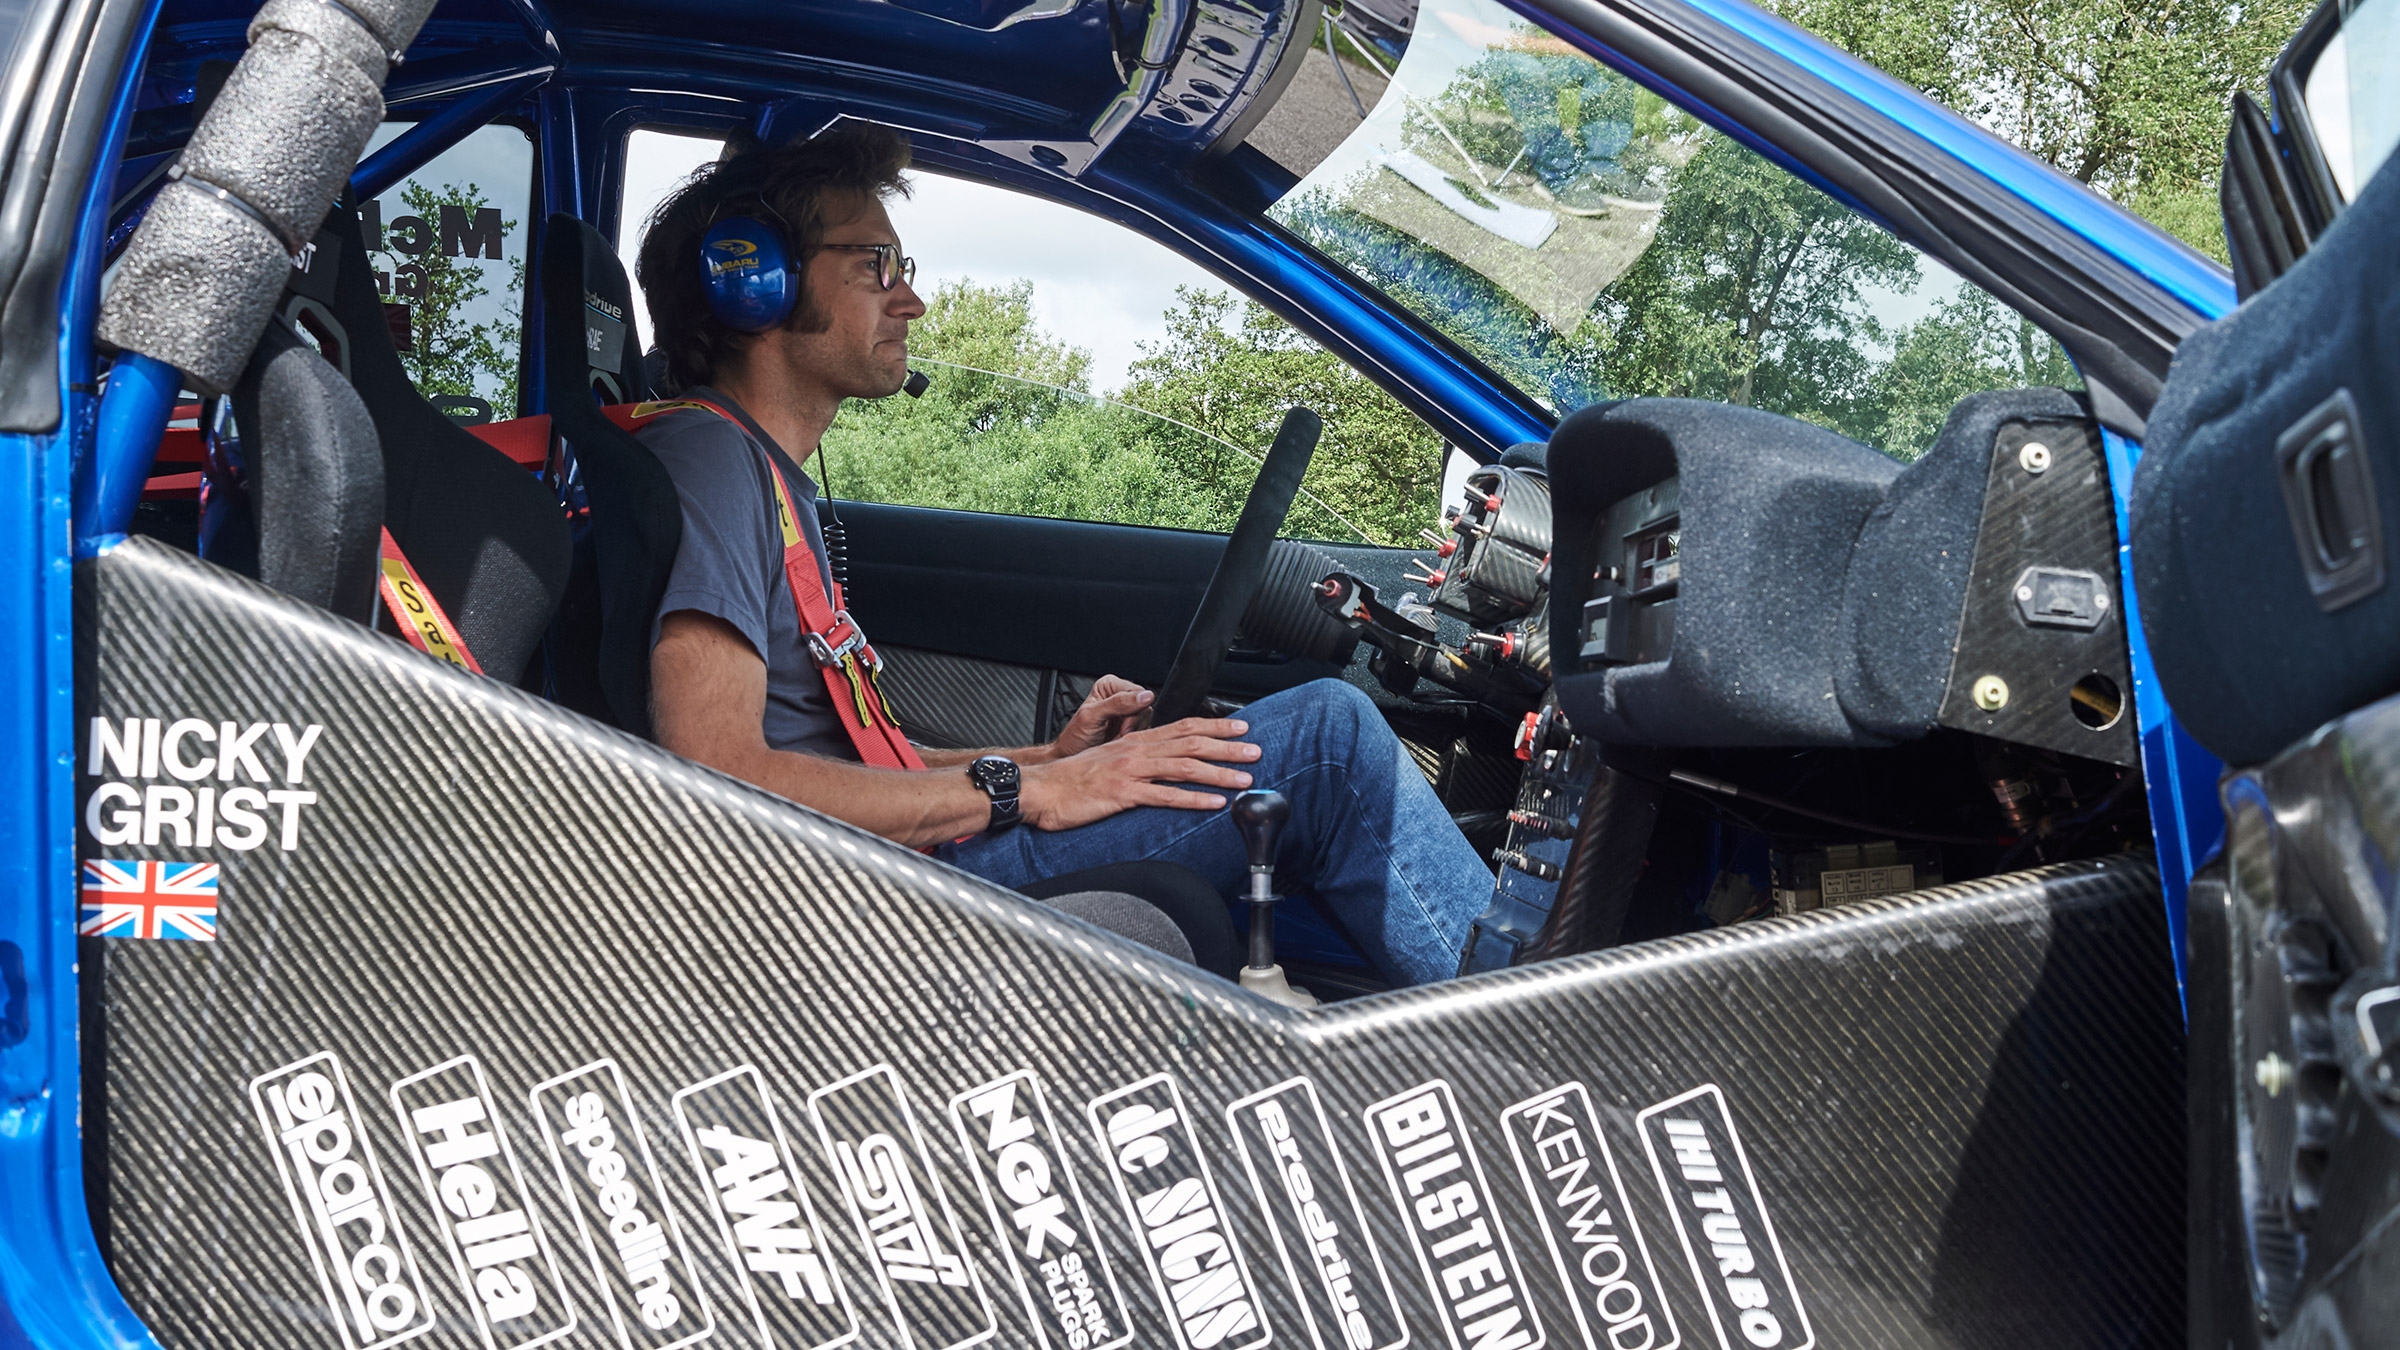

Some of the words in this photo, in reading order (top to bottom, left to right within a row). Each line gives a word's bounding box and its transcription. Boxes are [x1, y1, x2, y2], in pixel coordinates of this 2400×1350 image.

[85, 781, 318, 851] GRIST
[88, 716, 324, 784] NICKY
[267, 1071, 416, 1344] sparco
[411, 1095, 539, 1324] Hella
[561, 1091, 681, 1331] speedline
[695, 1124, 835, 1304] AWF
[968, 1081, 1078, 1260] NGK
[1378, 1091, 1533, 1350] BILSTEIN
[1522, 1095, 1656, 1350] KENWOOD
[1663, 1117, 1724, 1182] IHI
[1039, 1259, 1090, 1350] PLUGS
[1060, 1251, 1111, 1345] SPARK
[1135, 1176, 1259, 1350] SIGNS
[1691, 1186, 1784, 1348] TURBO
